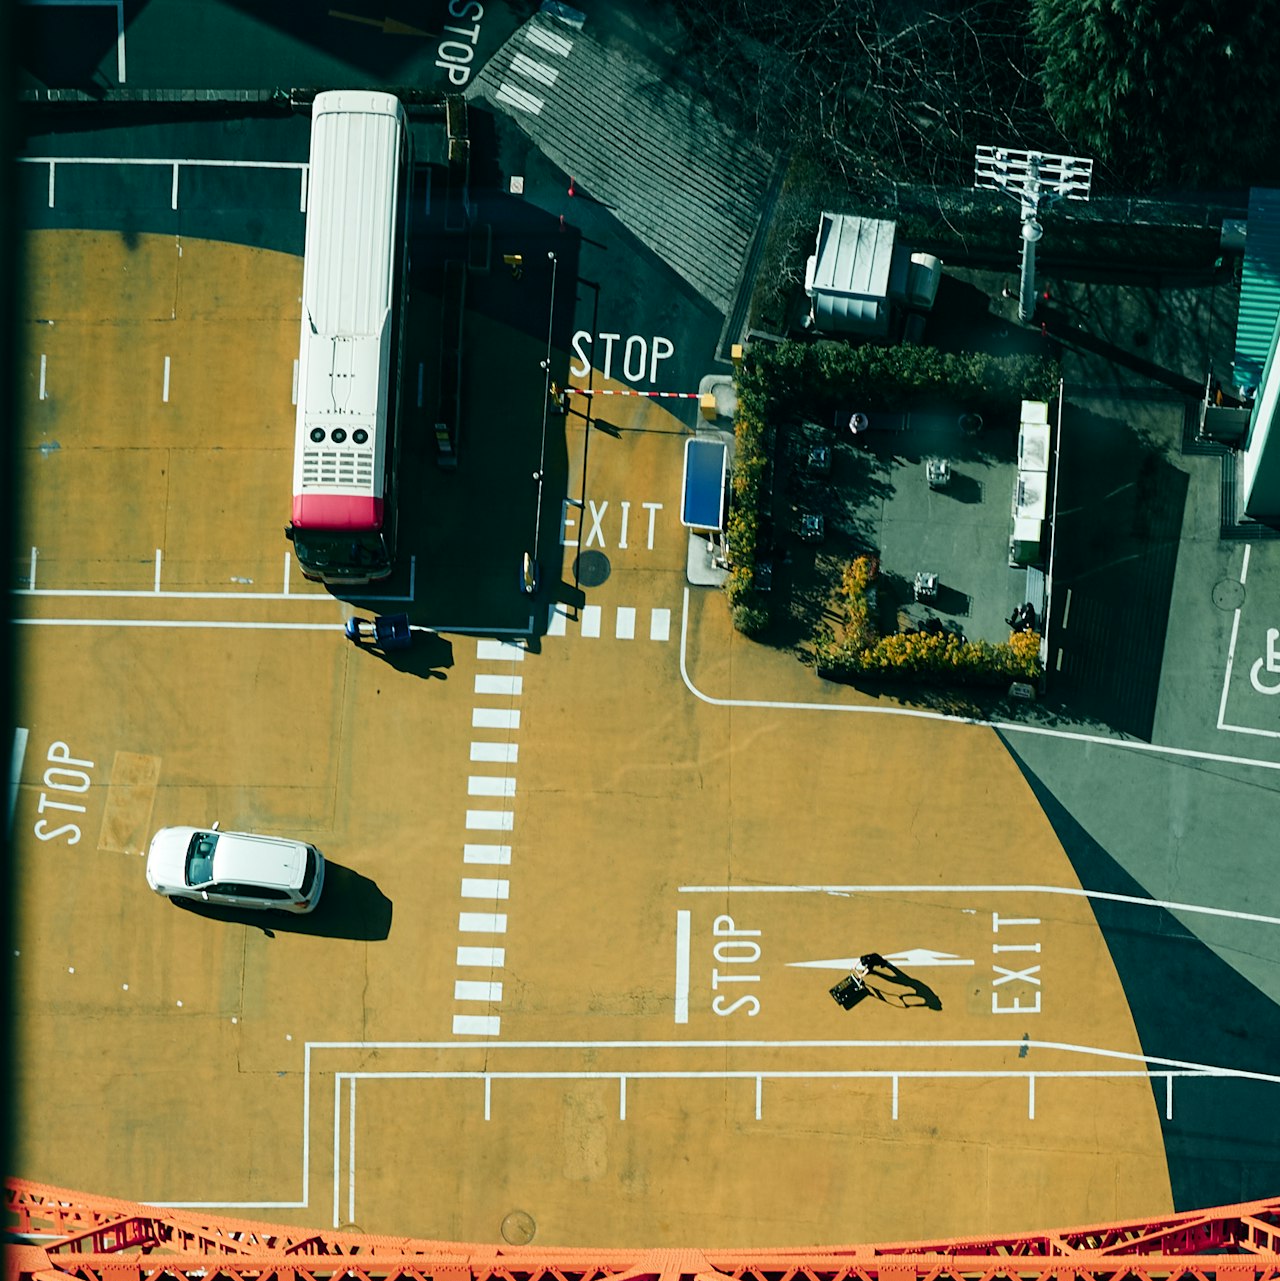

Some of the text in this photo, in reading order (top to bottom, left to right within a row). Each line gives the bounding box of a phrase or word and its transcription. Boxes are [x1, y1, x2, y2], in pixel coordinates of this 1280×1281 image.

[435, 0, 484, 86] STOP
[570, 330, 674, 384] STOP
[560, 499, 663, 550] EXIT
[34, 741, 95, 845] STOP
[711, 914, 762, 1017] STOP
[991, 912, 1041, 1014] EXIT
